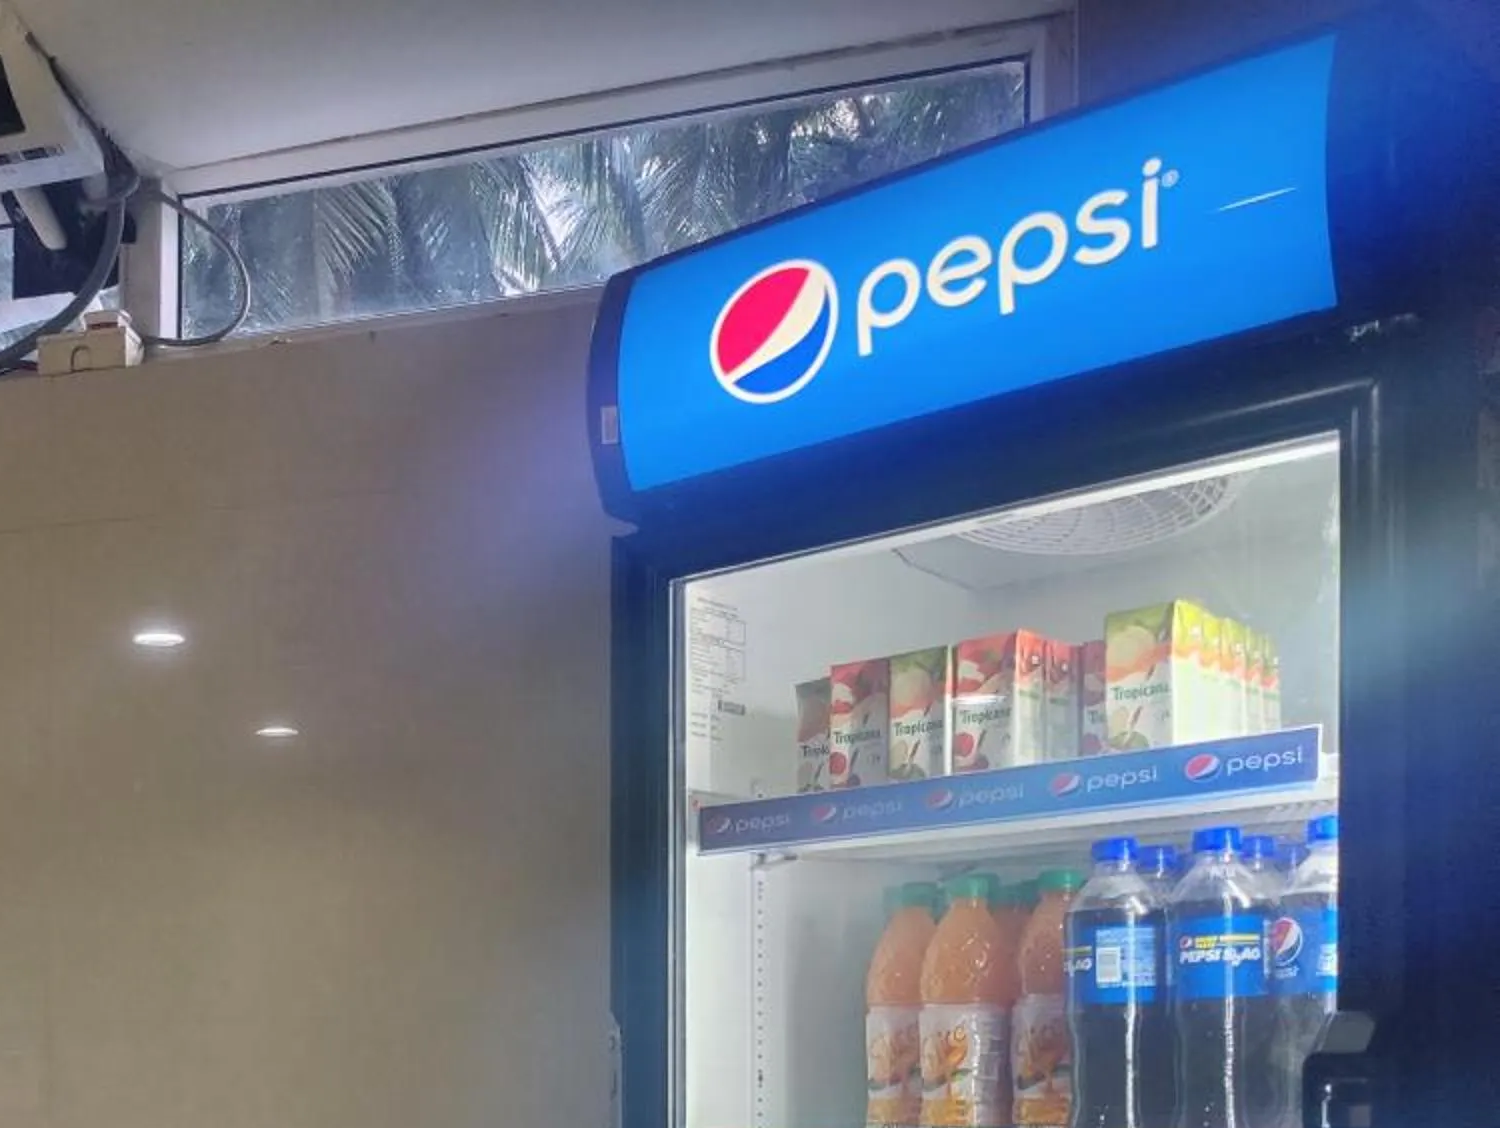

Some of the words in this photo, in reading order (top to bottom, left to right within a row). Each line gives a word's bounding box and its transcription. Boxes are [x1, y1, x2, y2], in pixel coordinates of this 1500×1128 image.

[856, 157, 1162, 357] pepsi
[1111, 684, 1171, 701] Tropicana
[960, 707, 1011, 724] Tropicana
[894, 719, 943, 737] Tropicana
[833, 729, 881, 745] Tropicana
[733, 814, 792, 834] pepsi
[842, 801, 903, 822] pepsi
[957, 784, 1025, 808] pepsi
[1087, 766, 1159, 792] pepsi
[1226, 746, 1303, 778] pepsi
